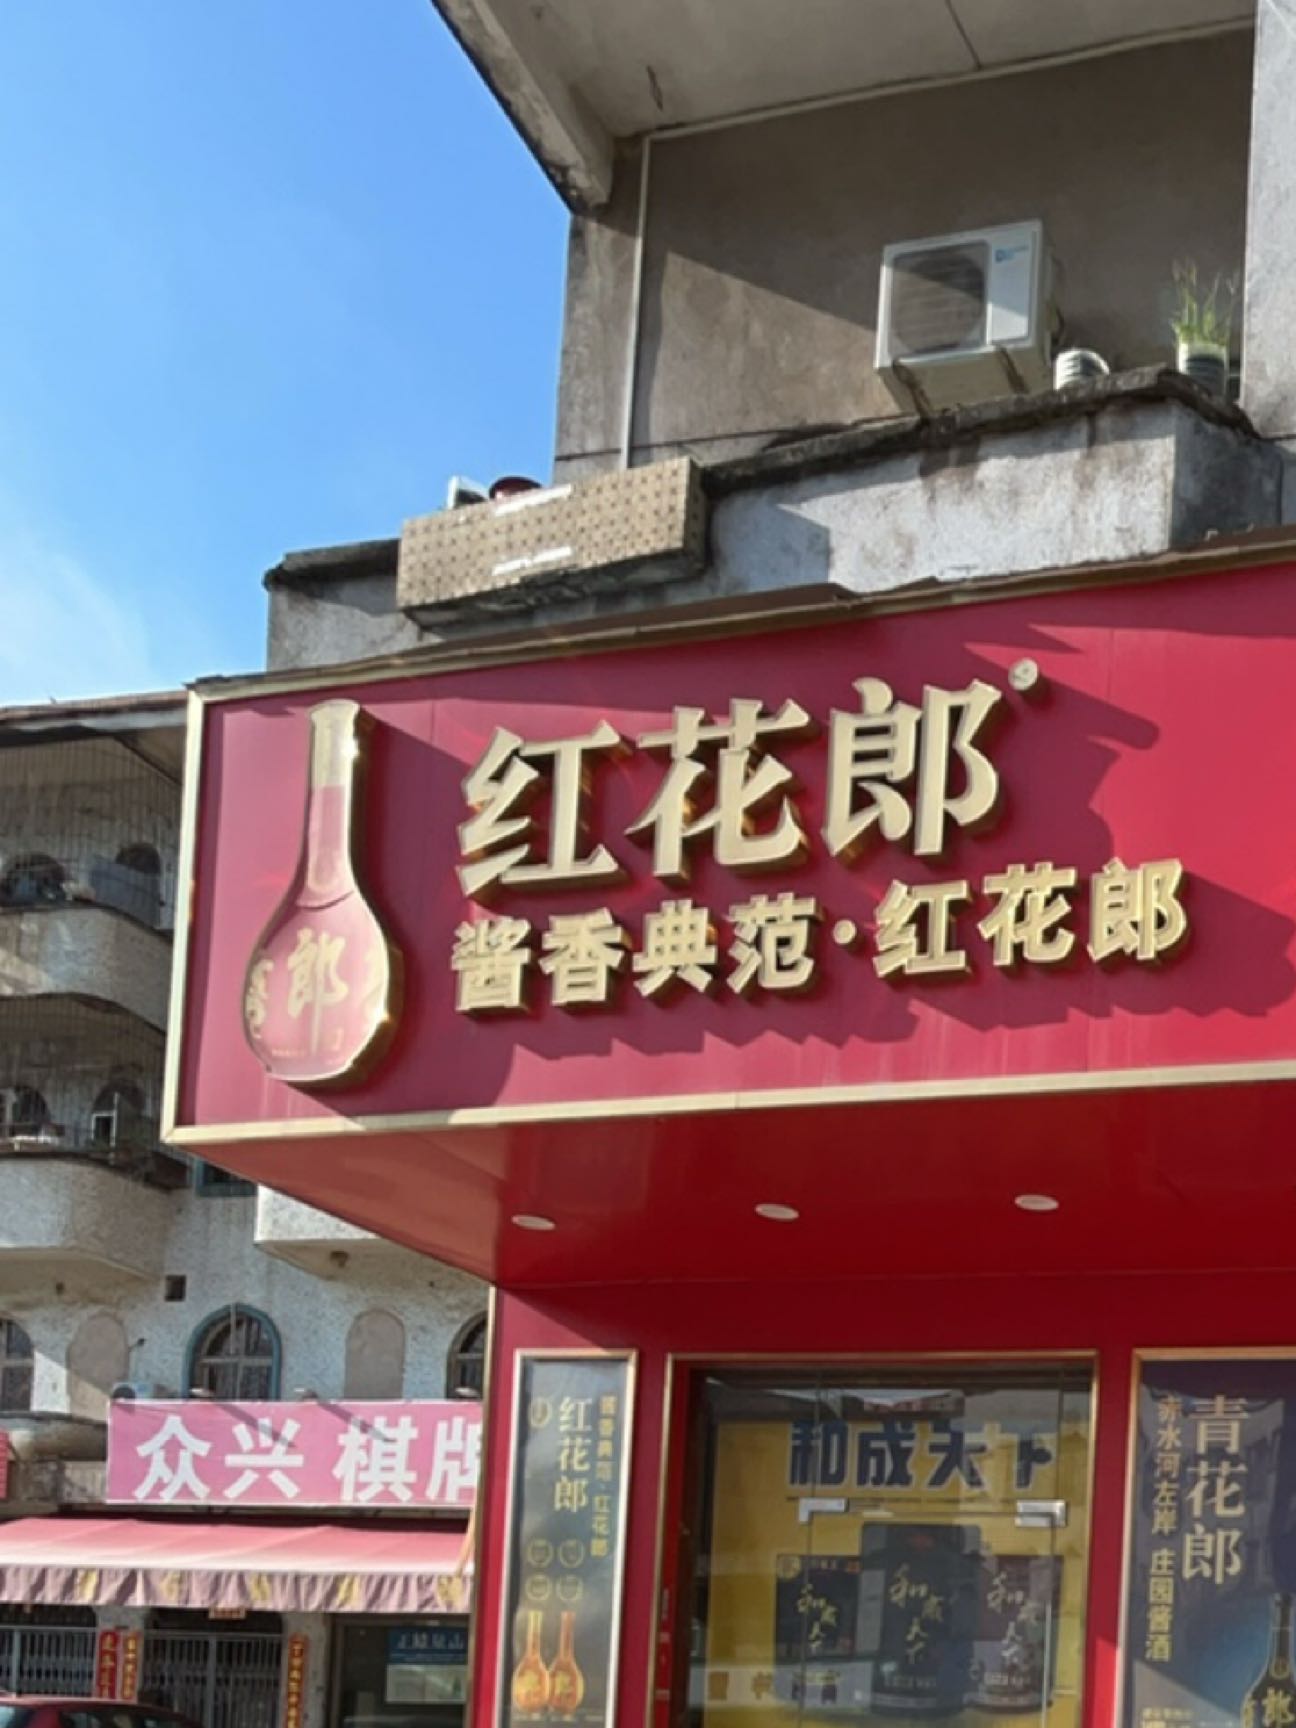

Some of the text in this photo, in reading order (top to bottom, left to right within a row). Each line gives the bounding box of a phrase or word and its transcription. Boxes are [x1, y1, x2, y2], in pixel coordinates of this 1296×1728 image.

[455, 676, 1003, 896] 红花郎
[449, 857, 1190, 1014] 酱香典范·红花郎
[554, 1396, 593, 1513] 红花郎
[1182, 1395, 1249, 1585] 青花郎
